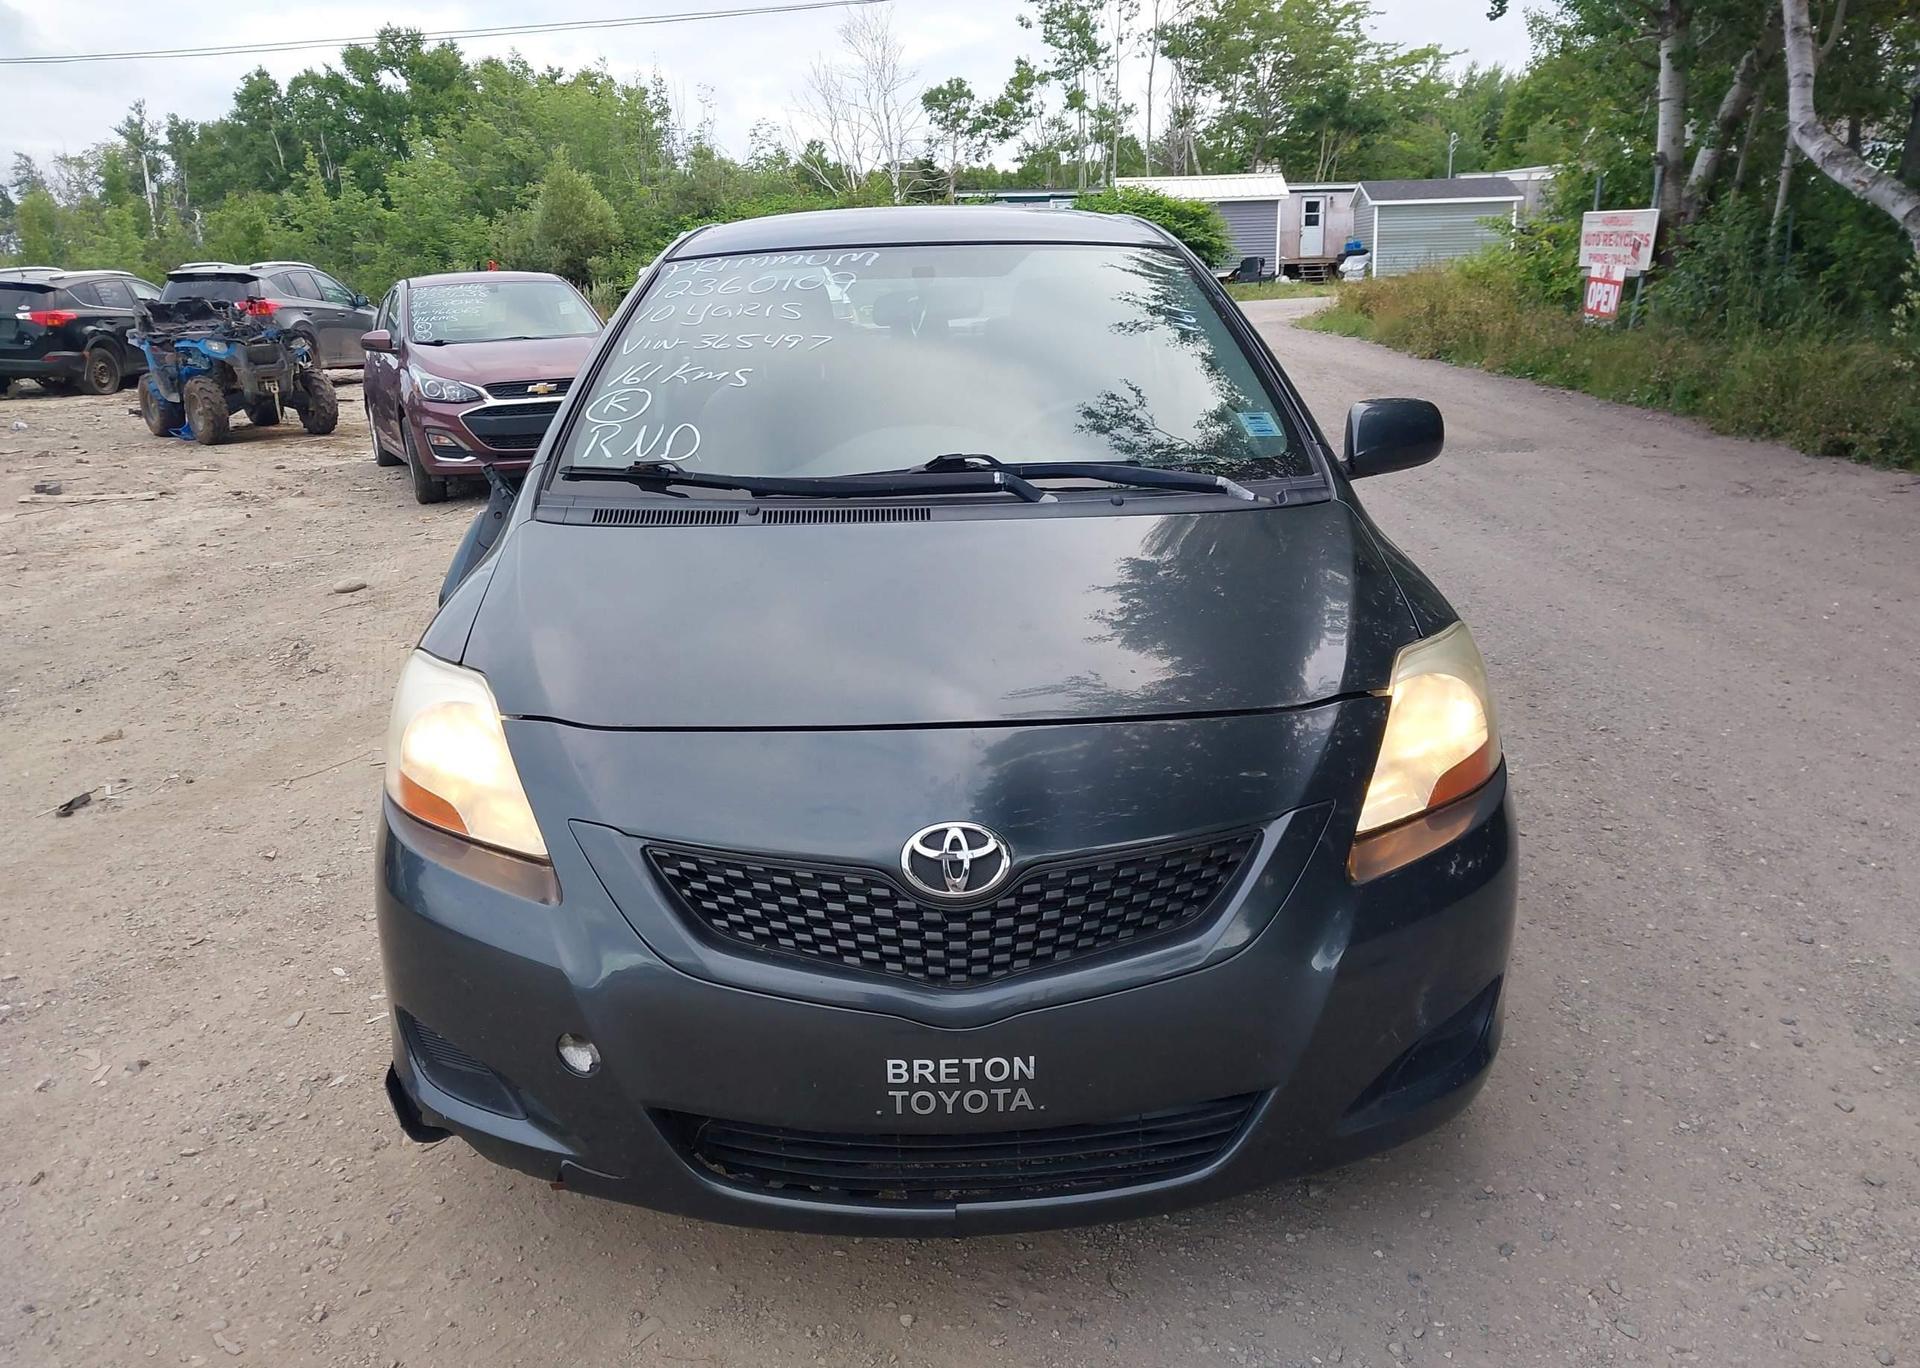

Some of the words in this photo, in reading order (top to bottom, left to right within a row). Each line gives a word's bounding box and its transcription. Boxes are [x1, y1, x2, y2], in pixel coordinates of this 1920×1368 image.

[1587, 281, 1620, 312] OPEN
[635, 304, 676, 324] 10
[607, 361, 663, 387] 161
[886, 1055, 1035, 1084] BRETON
[888, 1087, 1035, 1115] TOYOTA
